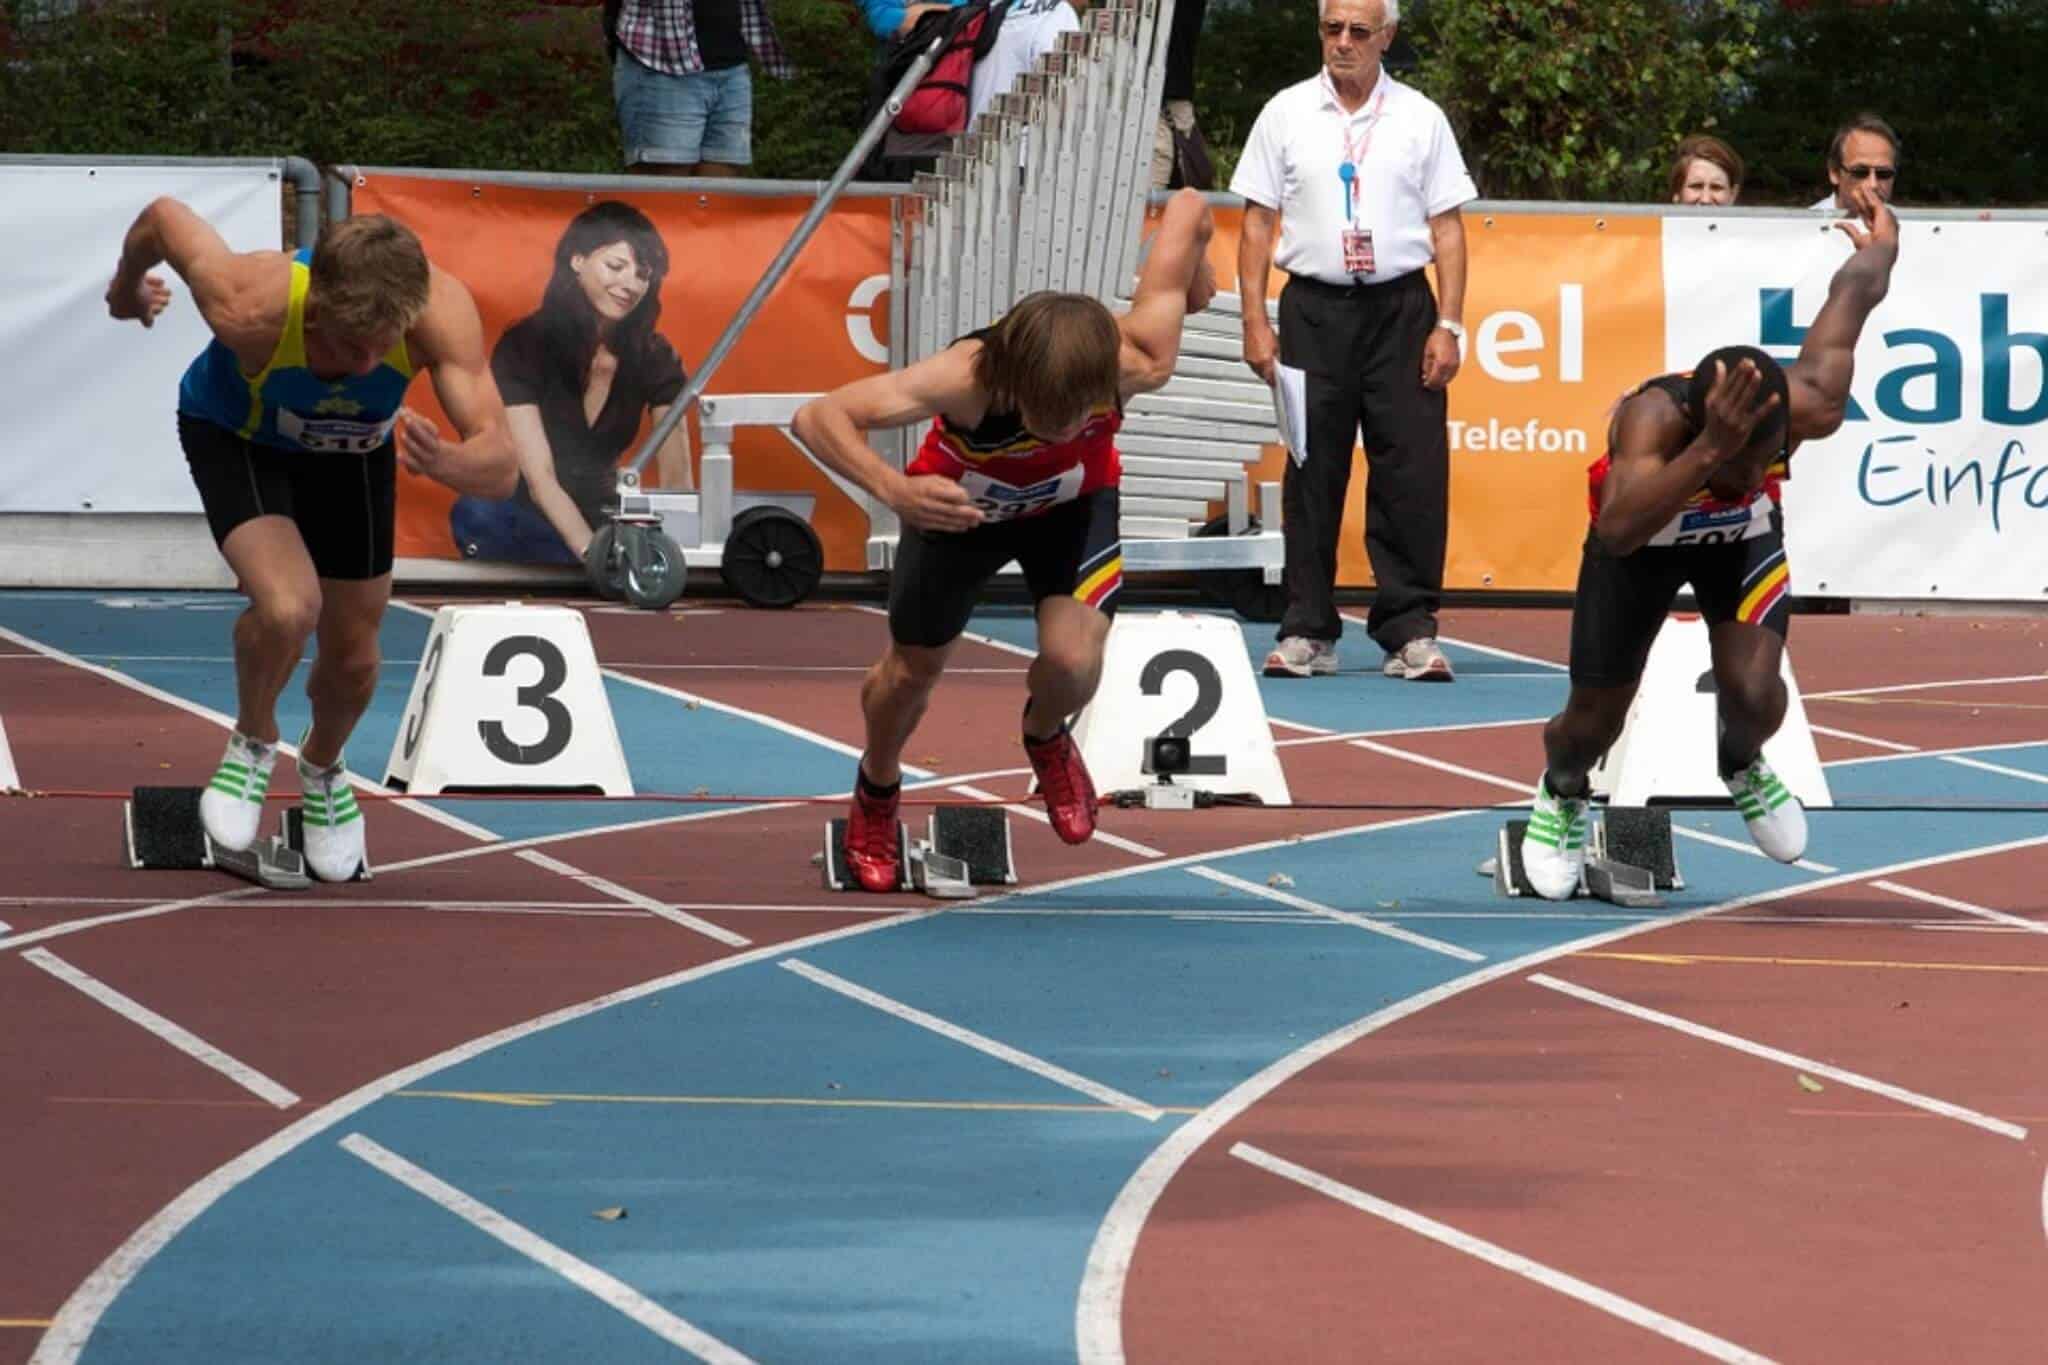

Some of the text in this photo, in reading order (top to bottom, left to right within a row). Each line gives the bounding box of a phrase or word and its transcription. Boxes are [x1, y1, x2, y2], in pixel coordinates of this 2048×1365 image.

[1459, 283, 1584, 383] el
[1446, 418, 1588, 453] Telefon
[477, 634, 573, 766] 3
[1139, 649, 1227, 776] 2
